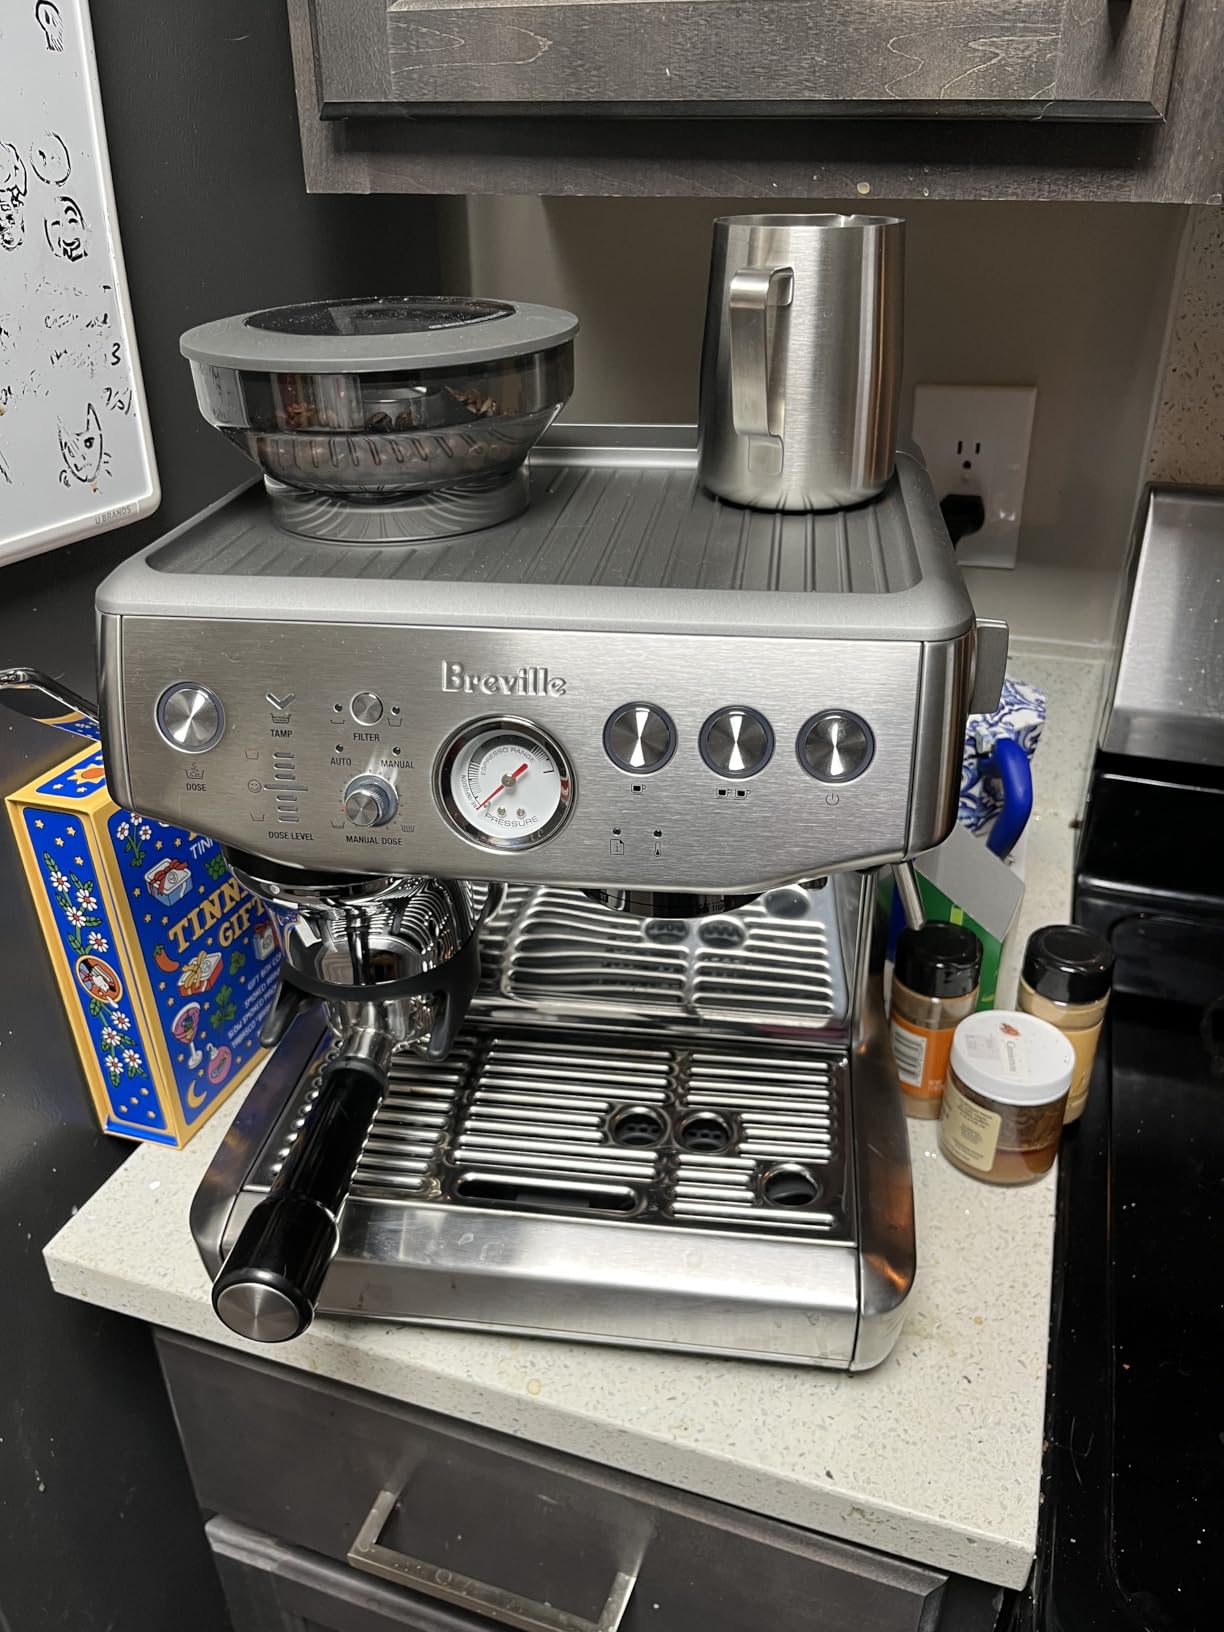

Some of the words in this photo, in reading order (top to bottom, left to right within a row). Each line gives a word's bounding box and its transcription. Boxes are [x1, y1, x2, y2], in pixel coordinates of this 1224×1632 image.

[442, 660, 567, 697] Breville
[270, 729, 293, 738] TAMP
[353, 732, 380, 742] FILTER
[330, 757, 352, 766] AUTO
[381, 759, 415, 769] MANUAL
[481, 747, 509, 776] ESPRESSO
[510, 747, 535, 764] RANGE
[186, 783, 207, 792] DOSE
[484, 812, 539, 828] PRESSURE
[268, 831, 290, 840] DOSE
[291, 832, 315, 841] LEVEL
[346, 835, 380, 845] MANUAL
[381, 836, 403, 846] DOSE
[168, 877, 250, 954] TINN
